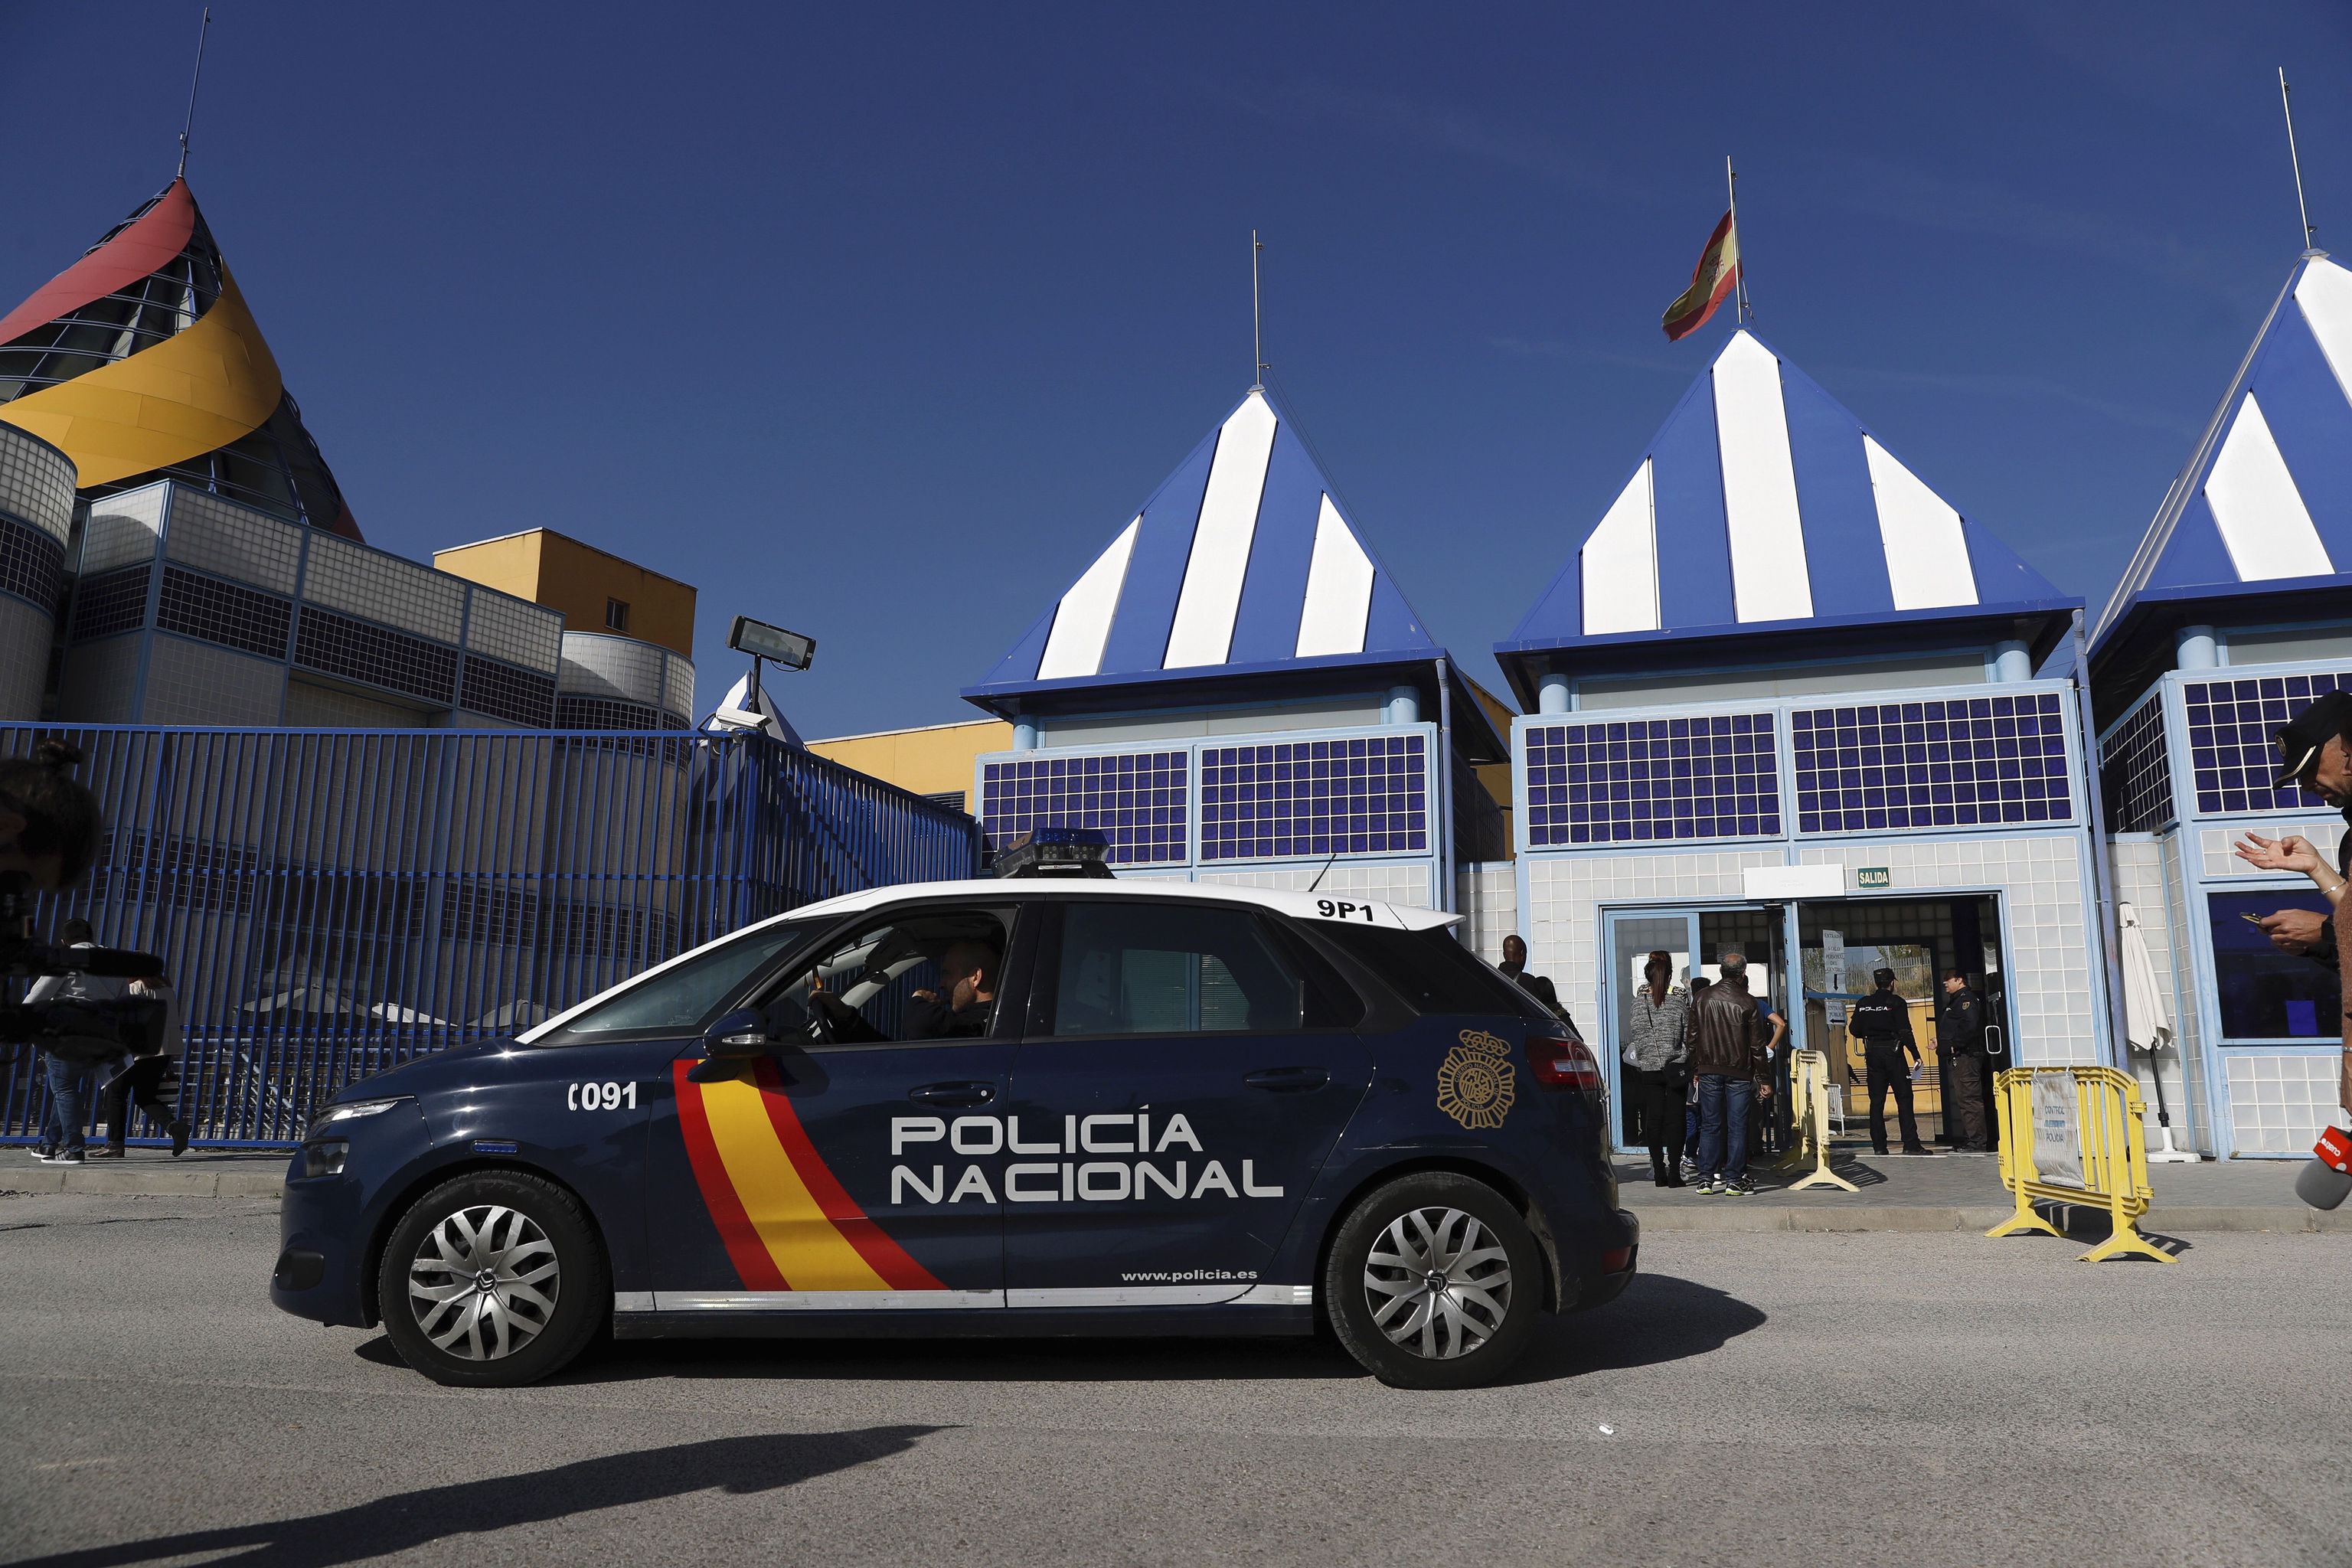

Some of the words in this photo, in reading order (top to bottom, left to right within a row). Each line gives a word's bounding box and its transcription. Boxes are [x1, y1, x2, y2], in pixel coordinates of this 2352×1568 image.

[1859, 871, 1889, 884] SALIDA
[1317, 899, 1374, 922] 9P1
[1454, 1063, 1473, 1083] CUERPO
[1474, 1063, 1499, 1085] NACIONAL
[1494, 1088, 1499, 1096] DE
[582, 1081, 636, 1111] 091
[1460, 1097, 1485, 1109] POLICIA
[2044, 1106, 2065, 1115] CONTROL
[891, 1104, 1204, 1155] POLICÍA
[891, 1159, 1284, 1204] NACIONAL
[1121, 1269, 1258, 1282] www.policia.es
